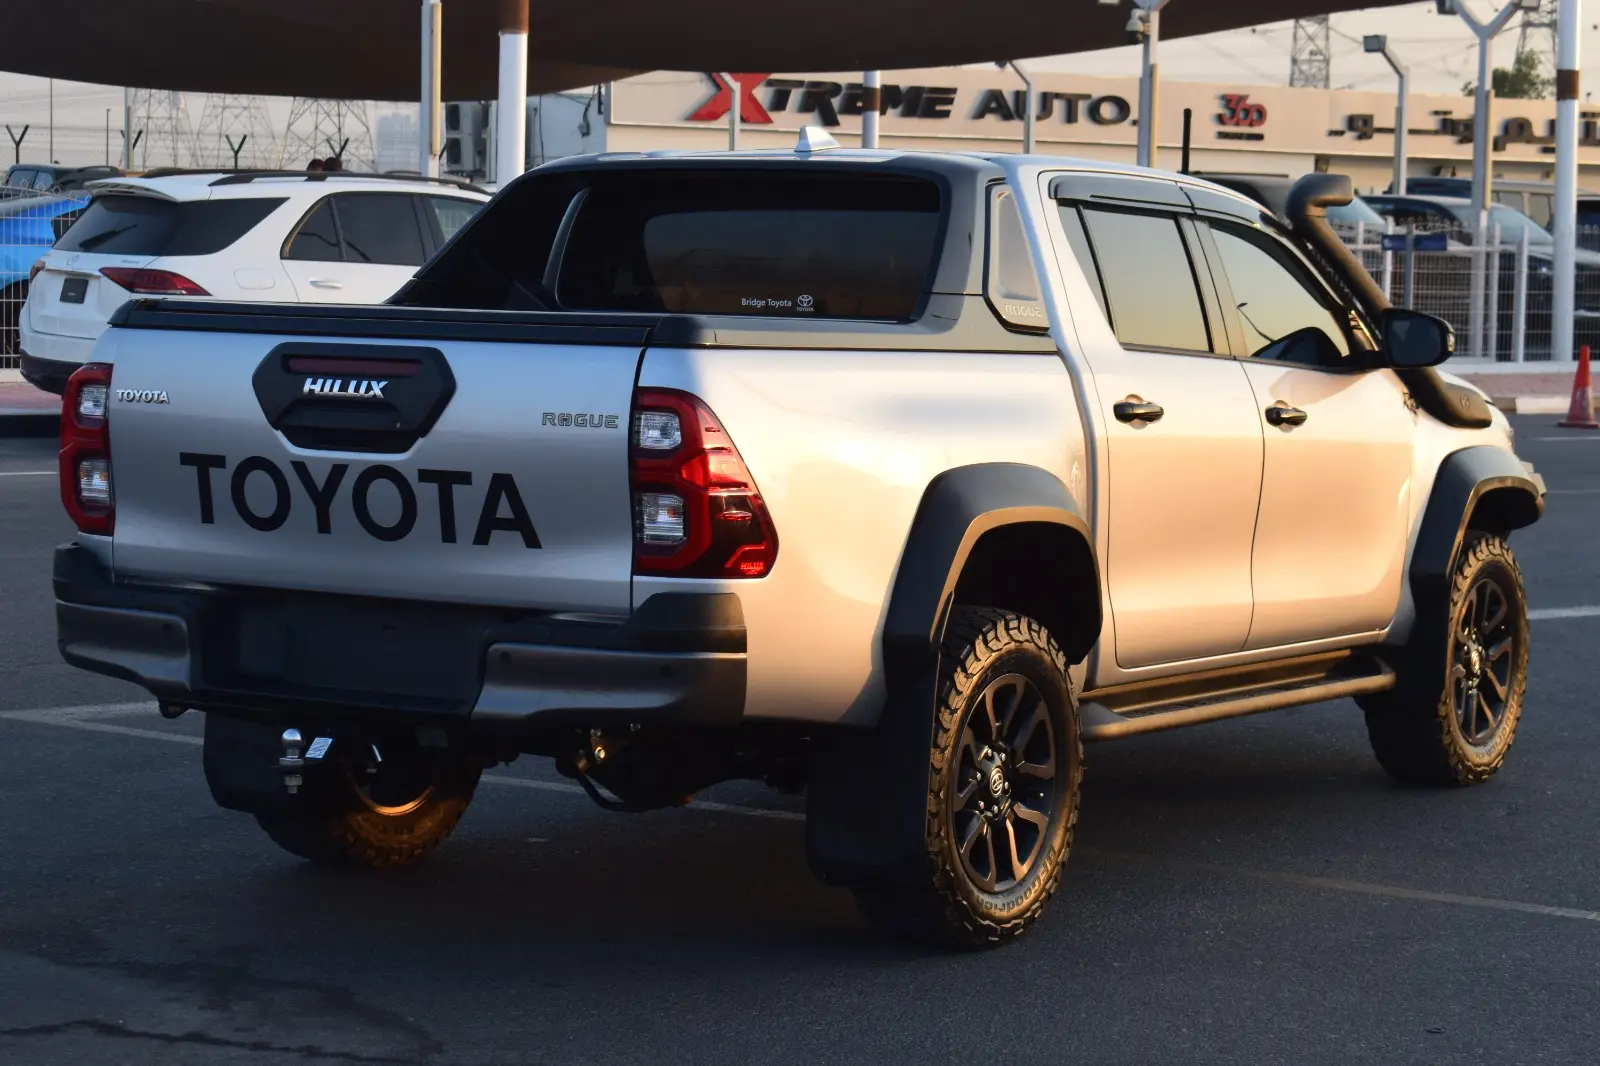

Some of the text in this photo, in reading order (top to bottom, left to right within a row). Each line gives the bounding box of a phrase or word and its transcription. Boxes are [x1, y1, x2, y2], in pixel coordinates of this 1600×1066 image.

[684, 72, 957, 126] XTREME
[1217, 94, 1267, 126] 360
[741, 298, 792, 308] Bridge Toyota
[1005, 304, 1042, 317] ROGUE
[116, 389, 170, 404] TOYOTA
[303, 377, 388, 399] HILUX
[541, 412, 619, 429] ROGUE
[179, 452, 543, 550] TOYOTA
[740, 561, 764, 570] HILUX
